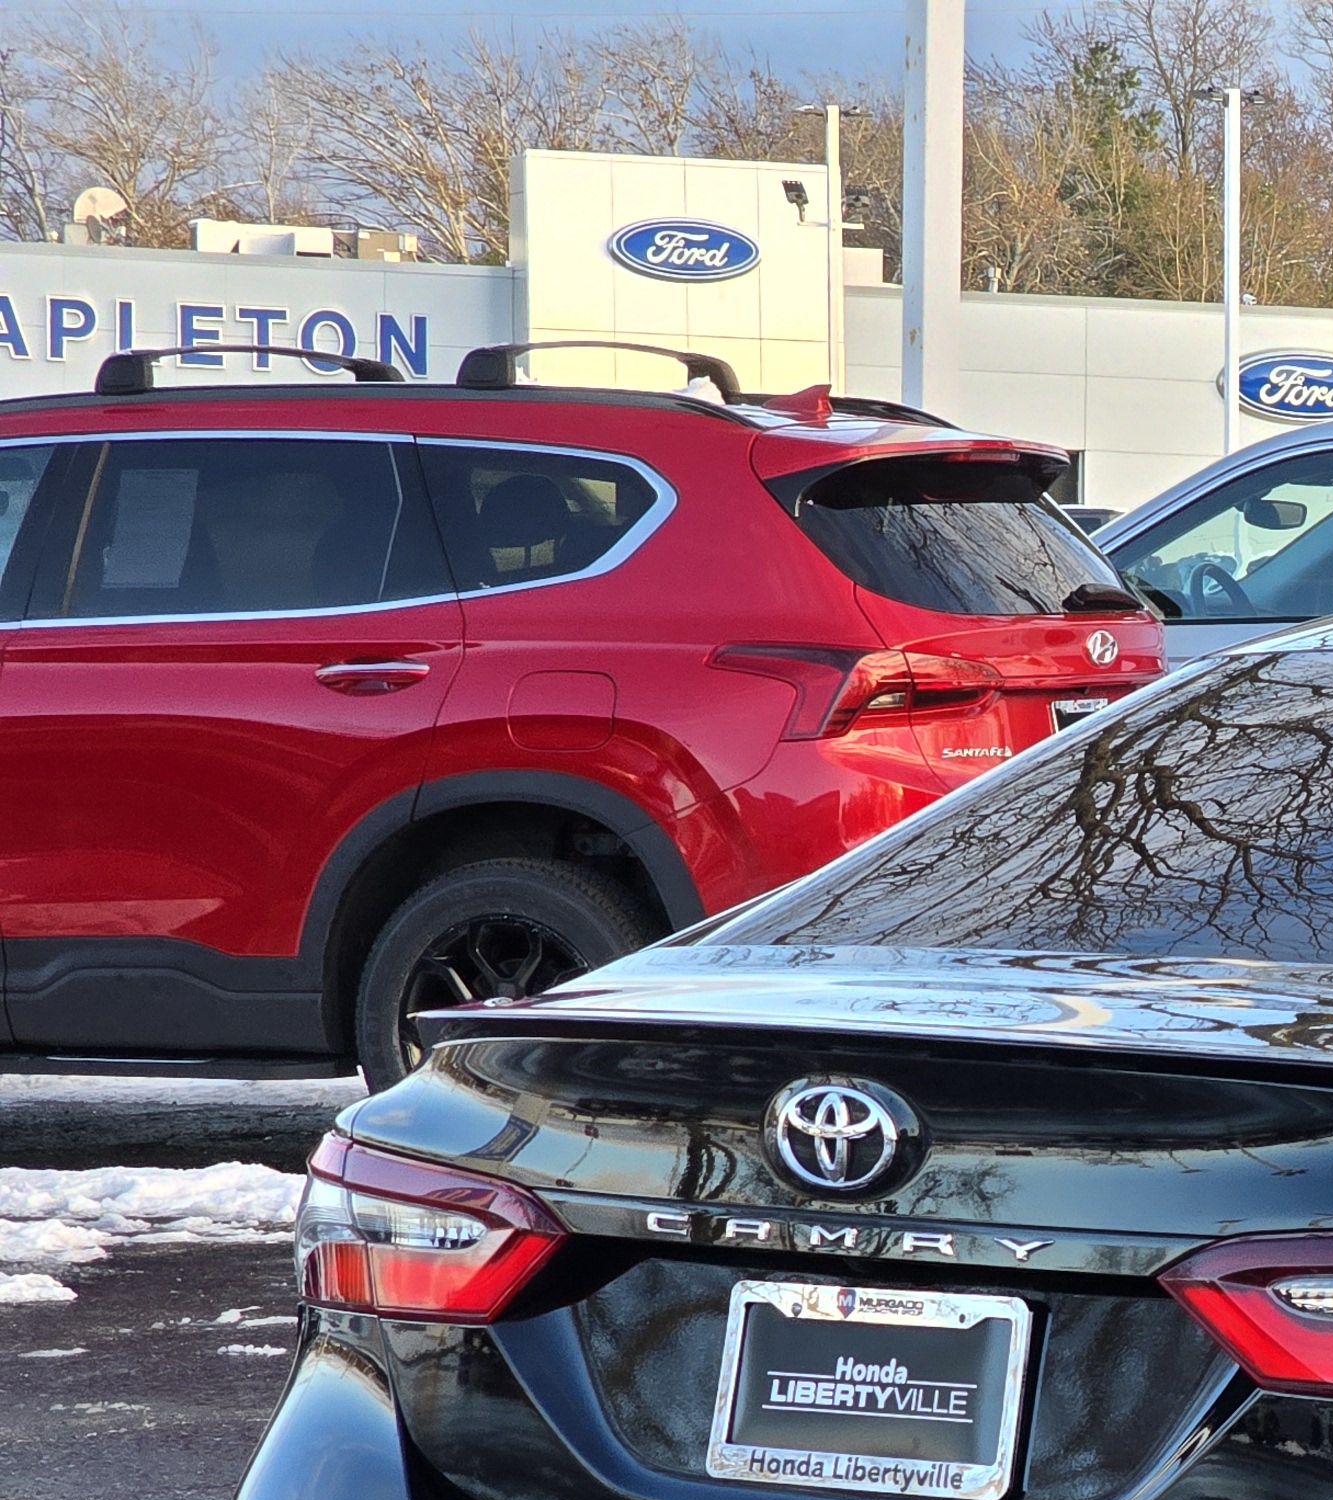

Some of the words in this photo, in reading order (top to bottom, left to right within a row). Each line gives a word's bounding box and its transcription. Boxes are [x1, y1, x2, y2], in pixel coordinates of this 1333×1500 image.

[646, 230, 730, 267] Ford
[646, 1211, 1056, 1262] CAMRY
[859, 1297, 924, 1310] MURGADO
[835, 1356, 908, 1385] Honda
[769, 1379, 969, 1416] LIBERTYVILLE
[749, 1449, 823, 1479] Honda
[833, 1456, 963, 1493] Libertyville
